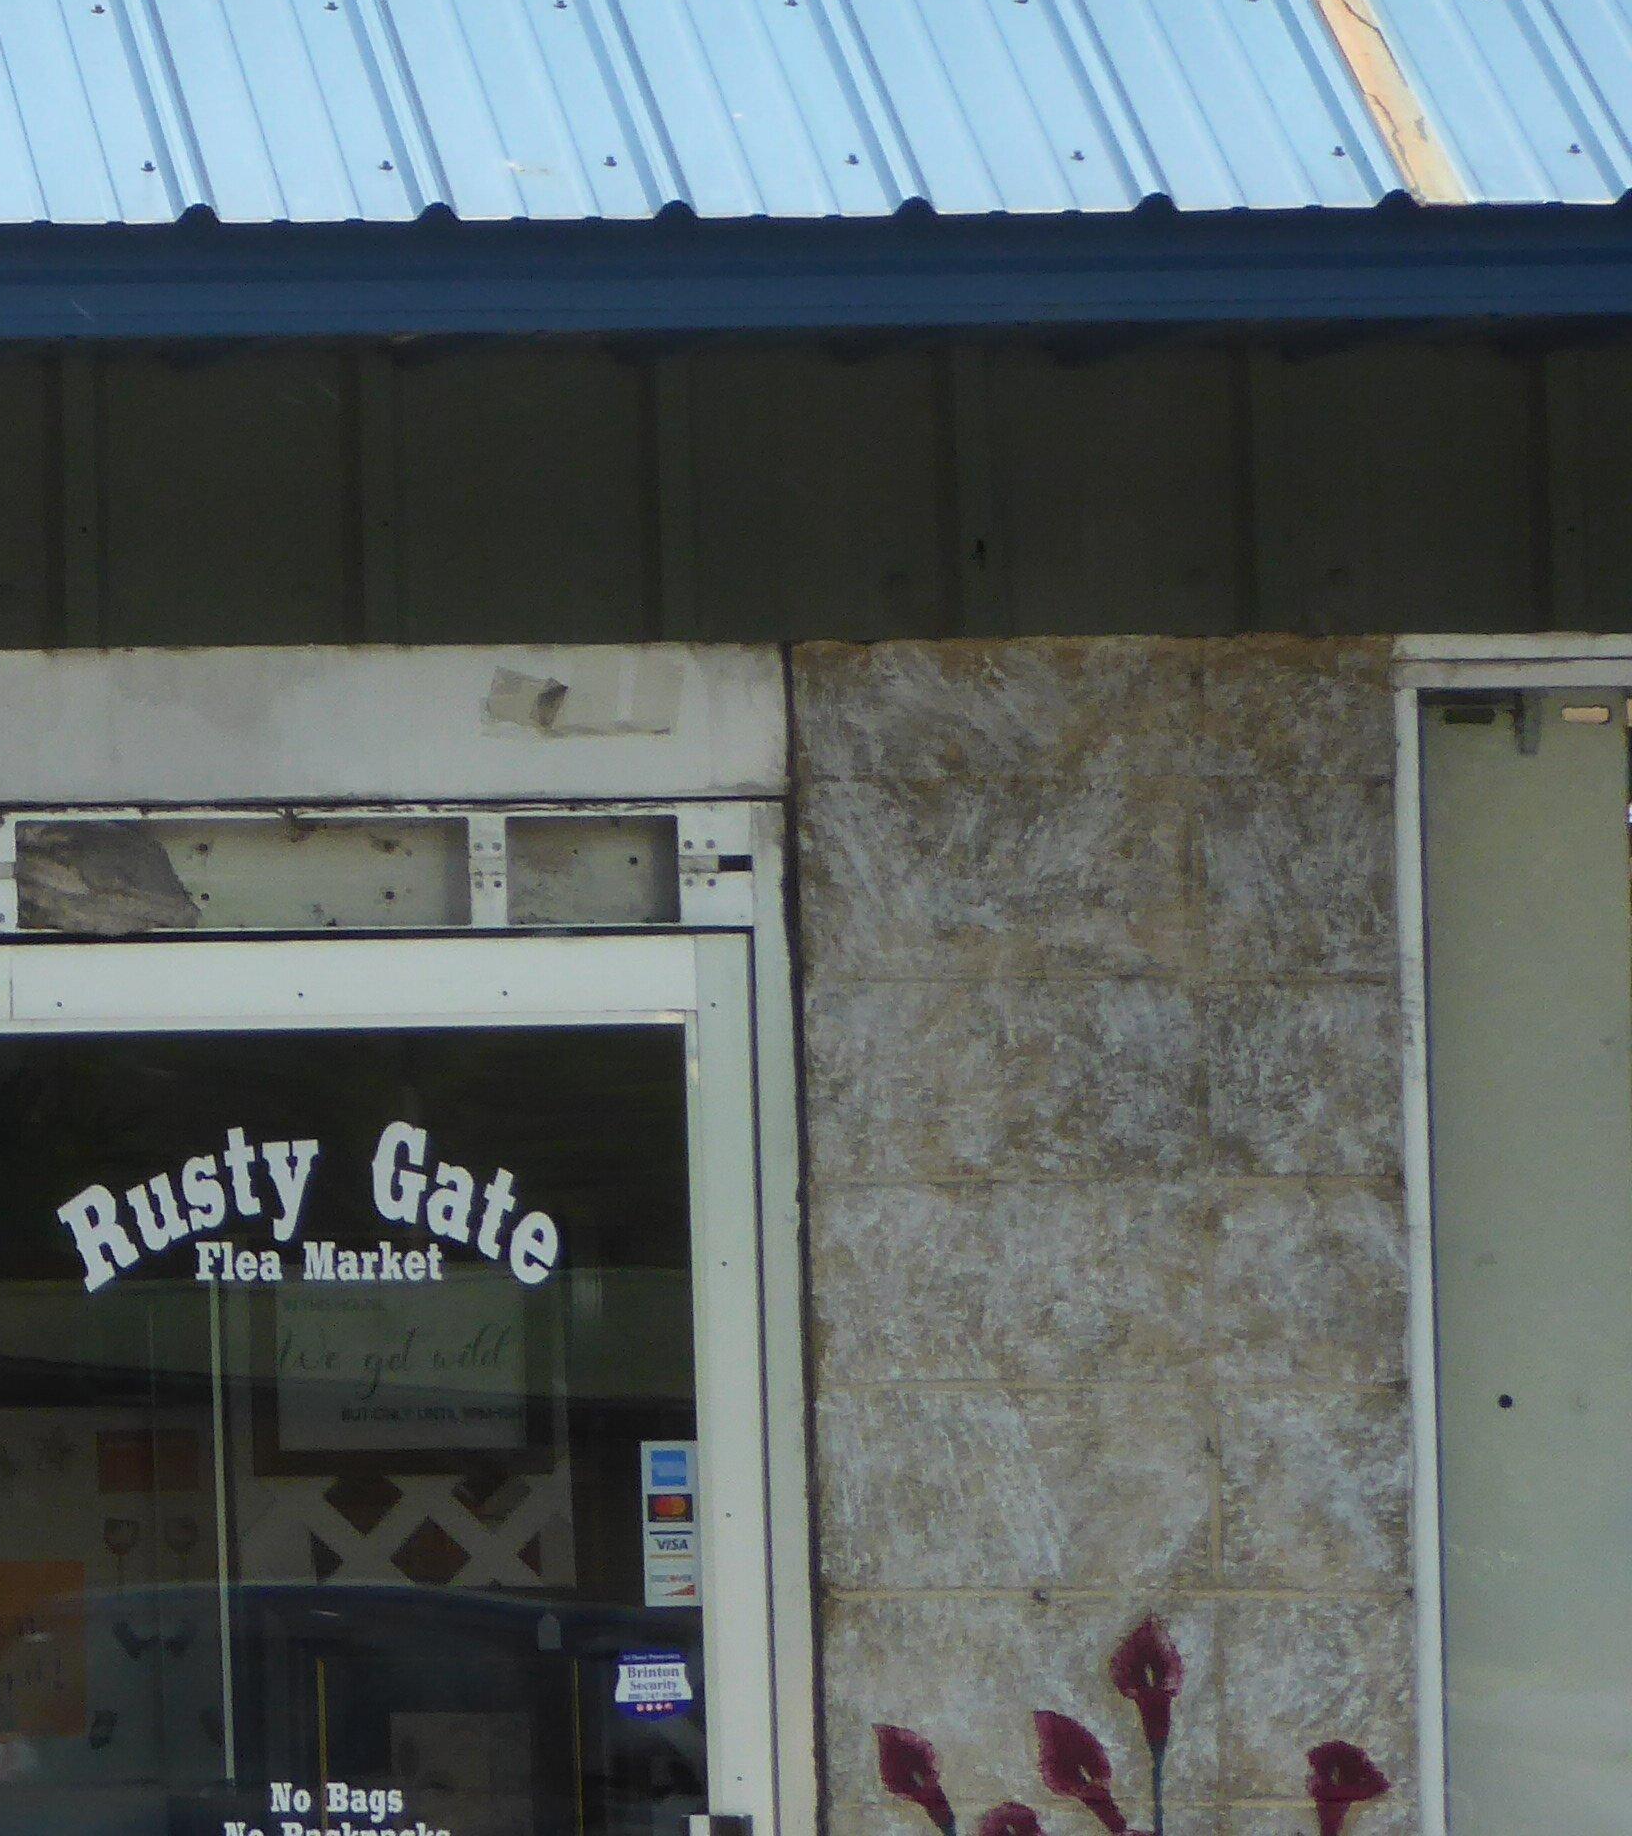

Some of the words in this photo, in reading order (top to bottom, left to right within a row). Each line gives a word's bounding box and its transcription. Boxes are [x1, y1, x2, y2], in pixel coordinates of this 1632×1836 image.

[56, 1126, 320, 1293] Rusty
[371, 1120, 559, 1285] Gate
[195, 1241, 283, 1282] Flea
[303, 1240, 444, 1282] Market
[656, 1539, 689, 1550] VISA
[630, 1679, 677, 1693] Security
[269, 1782, 312, 1813] No
[325, 1781, 404, 1824] Bags
